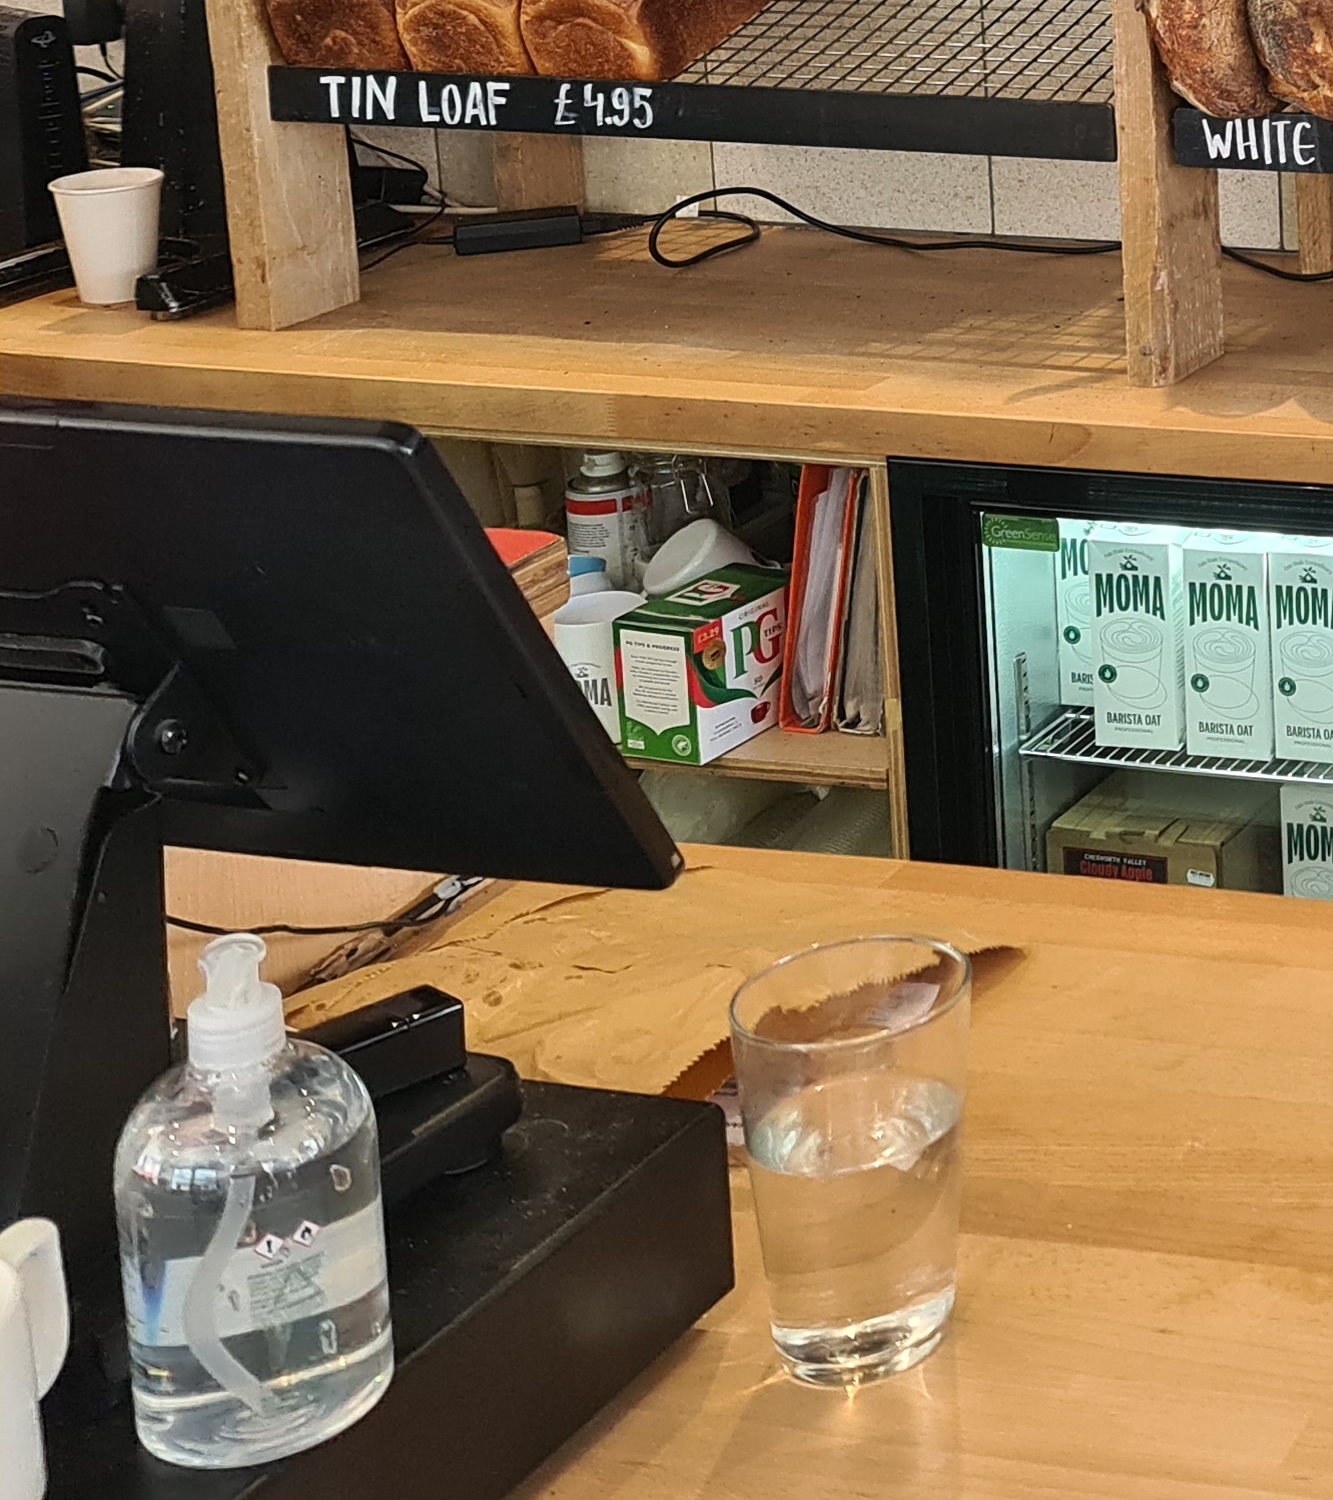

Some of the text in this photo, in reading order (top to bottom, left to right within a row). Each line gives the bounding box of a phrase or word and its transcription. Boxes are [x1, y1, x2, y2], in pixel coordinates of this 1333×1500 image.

[319, 74, 654, 129] TIN LOAF £4.95
[1200, 118, 1316, 167] WHITE
[991, 525, 1057, 542] GreenSense
[1061, 538, 1090, 580] MO
[1094, 573, 1166, 622] MOMA
[1188, 582, 1260, 632] MOMA
[1071, 672, 1093, 684] BARIS
[1106, 711, 1162, 727] BARISTA OAT
[1198, 721, 1254, 737] BARISTA OAT
[1286, 725, 1322, 740] BARISTA
